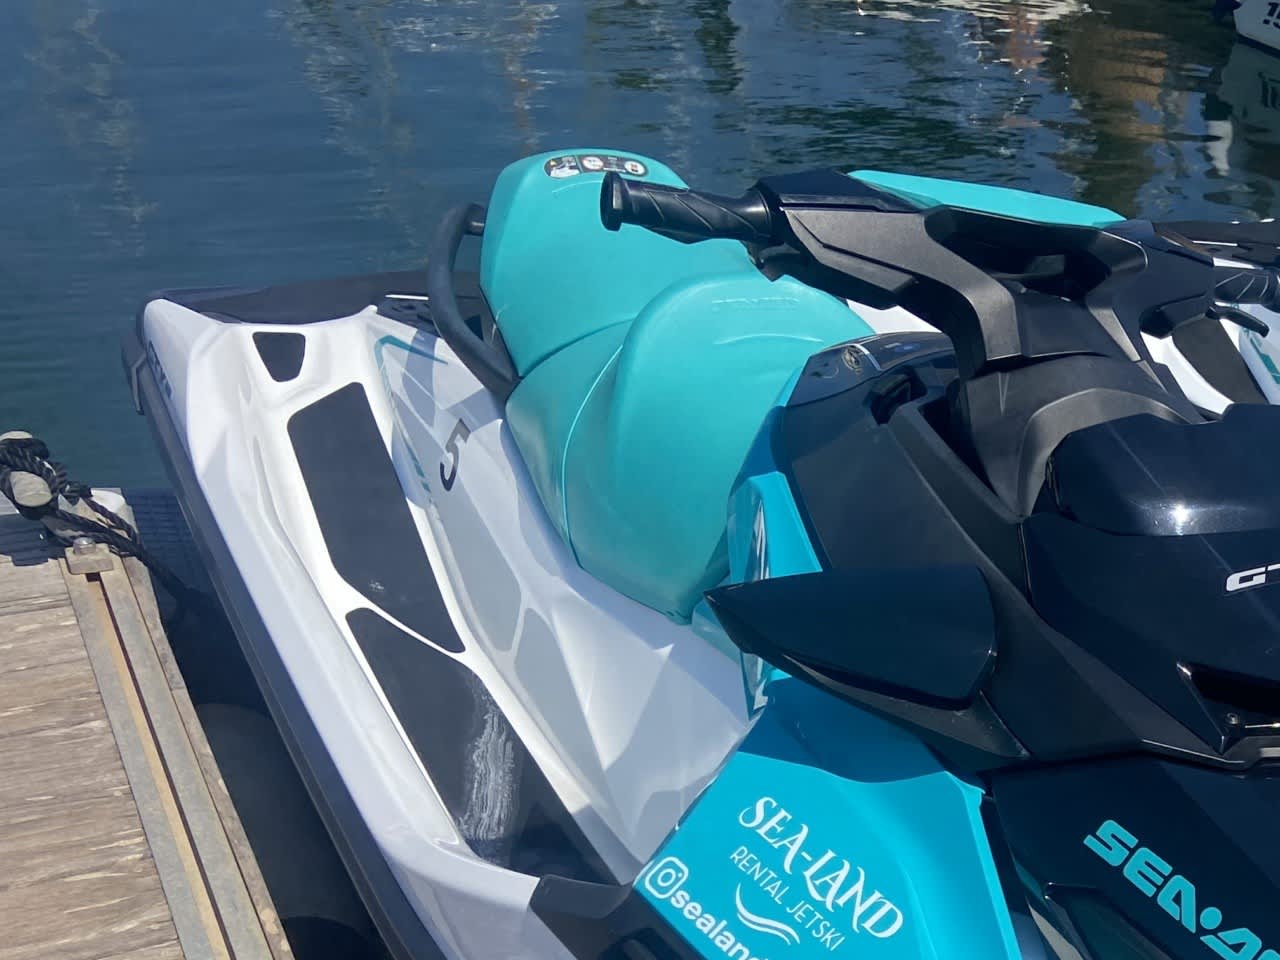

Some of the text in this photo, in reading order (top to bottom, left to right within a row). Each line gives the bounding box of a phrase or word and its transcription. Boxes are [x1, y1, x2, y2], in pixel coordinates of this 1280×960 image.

[440, 418, 472, 491] 5
[729, 845, 846, 953] RENTAL JETSKI
[738, 796, 905, 940] SEA-LAND
